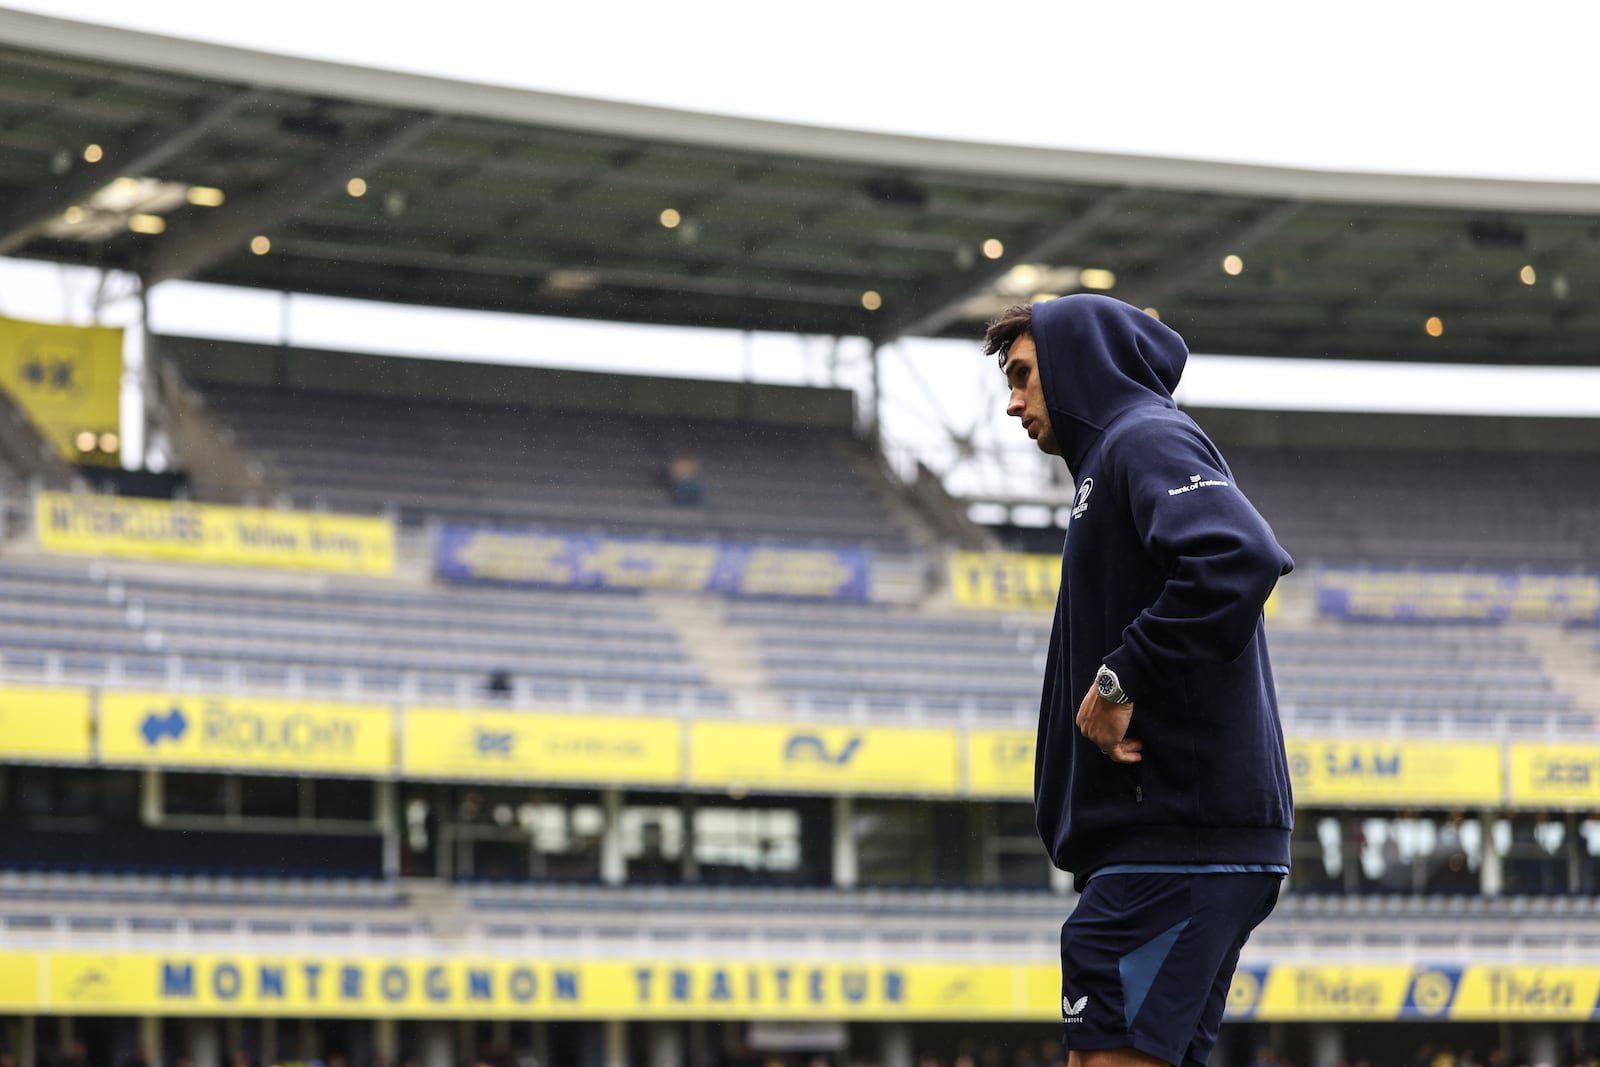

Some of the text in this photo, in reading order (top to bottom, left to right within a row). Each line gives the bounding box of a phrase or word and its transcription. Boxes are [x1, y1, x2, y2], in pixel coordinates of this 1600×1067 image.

[1168, 486, 1190, 495] Bank
[160, 961, 910, 1004] MONTROGNON TRAITEUR
